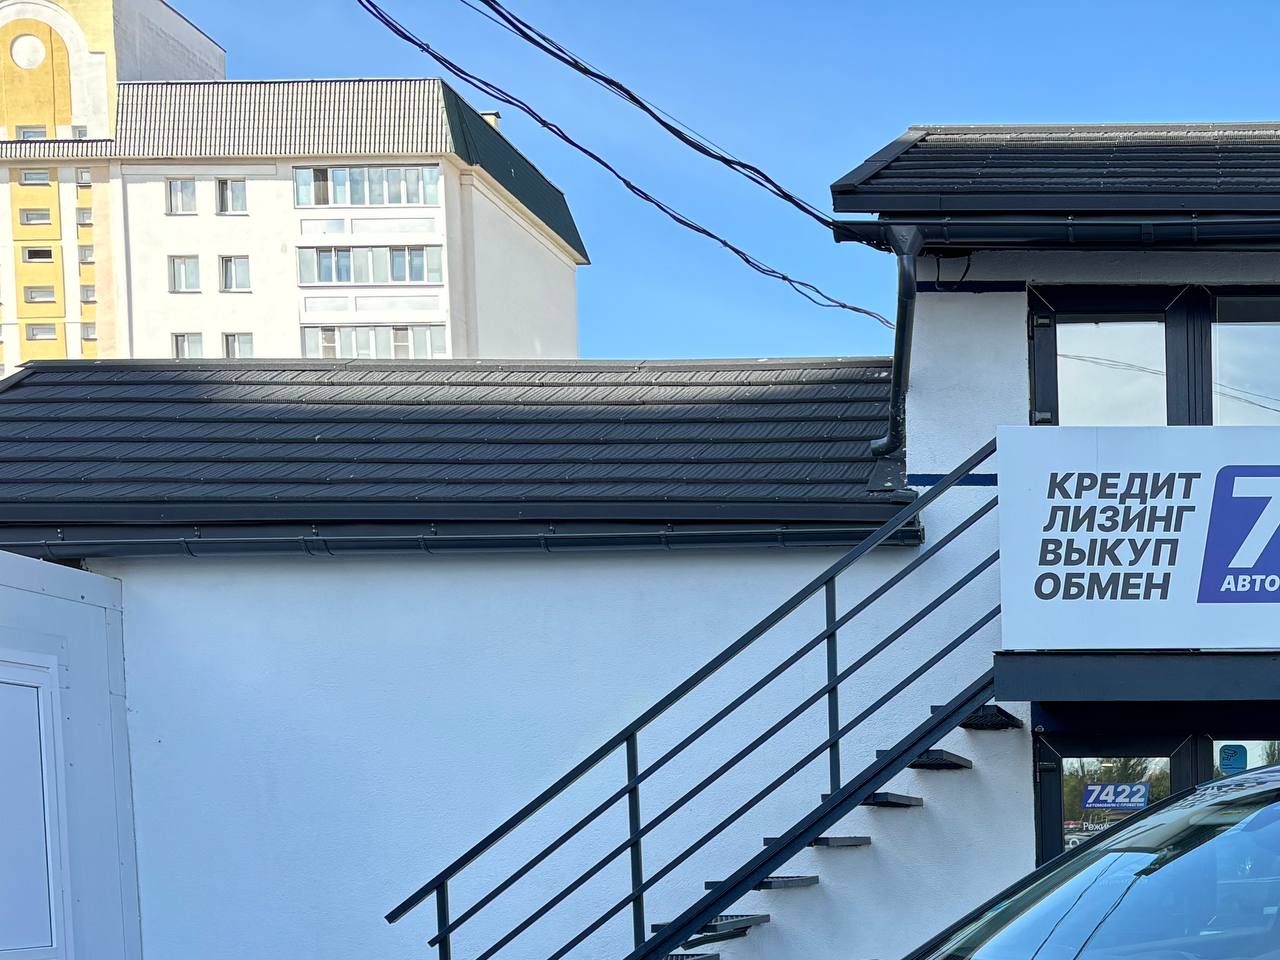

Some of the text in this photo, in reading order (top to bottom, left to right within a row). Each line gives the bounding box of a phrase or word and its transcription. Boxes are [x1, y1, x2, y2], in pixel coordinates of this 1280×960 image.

[1047, 472, 1201, 505] КРЕДИТ
[1042, 505, 1196, 532] ЛИЗИНГ
[1038, 538, 1179, 567] ВЫКУП
[1034, 572, 1171, 600] ОБМЕН
[1087, 785, 1146, 803] 7422
